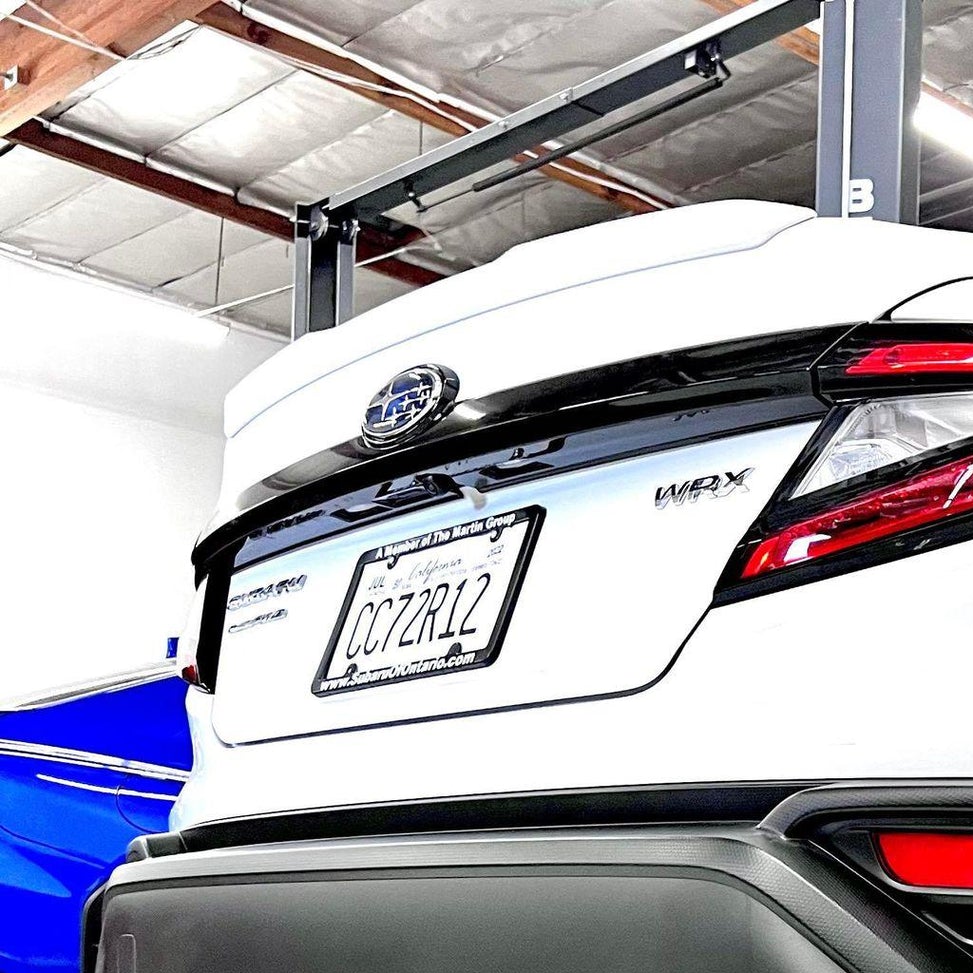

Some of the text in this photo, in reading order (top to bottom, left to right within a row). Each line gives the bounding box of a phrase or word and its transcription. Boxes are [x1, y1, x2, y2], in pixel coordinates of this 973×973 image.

[848, 178, 875, 213] B
[655, 467, 755, 510] WRX
[375, 512, 516, 560] A Member of The Martin Group
[346, 572, 491, 660] CC72R12
